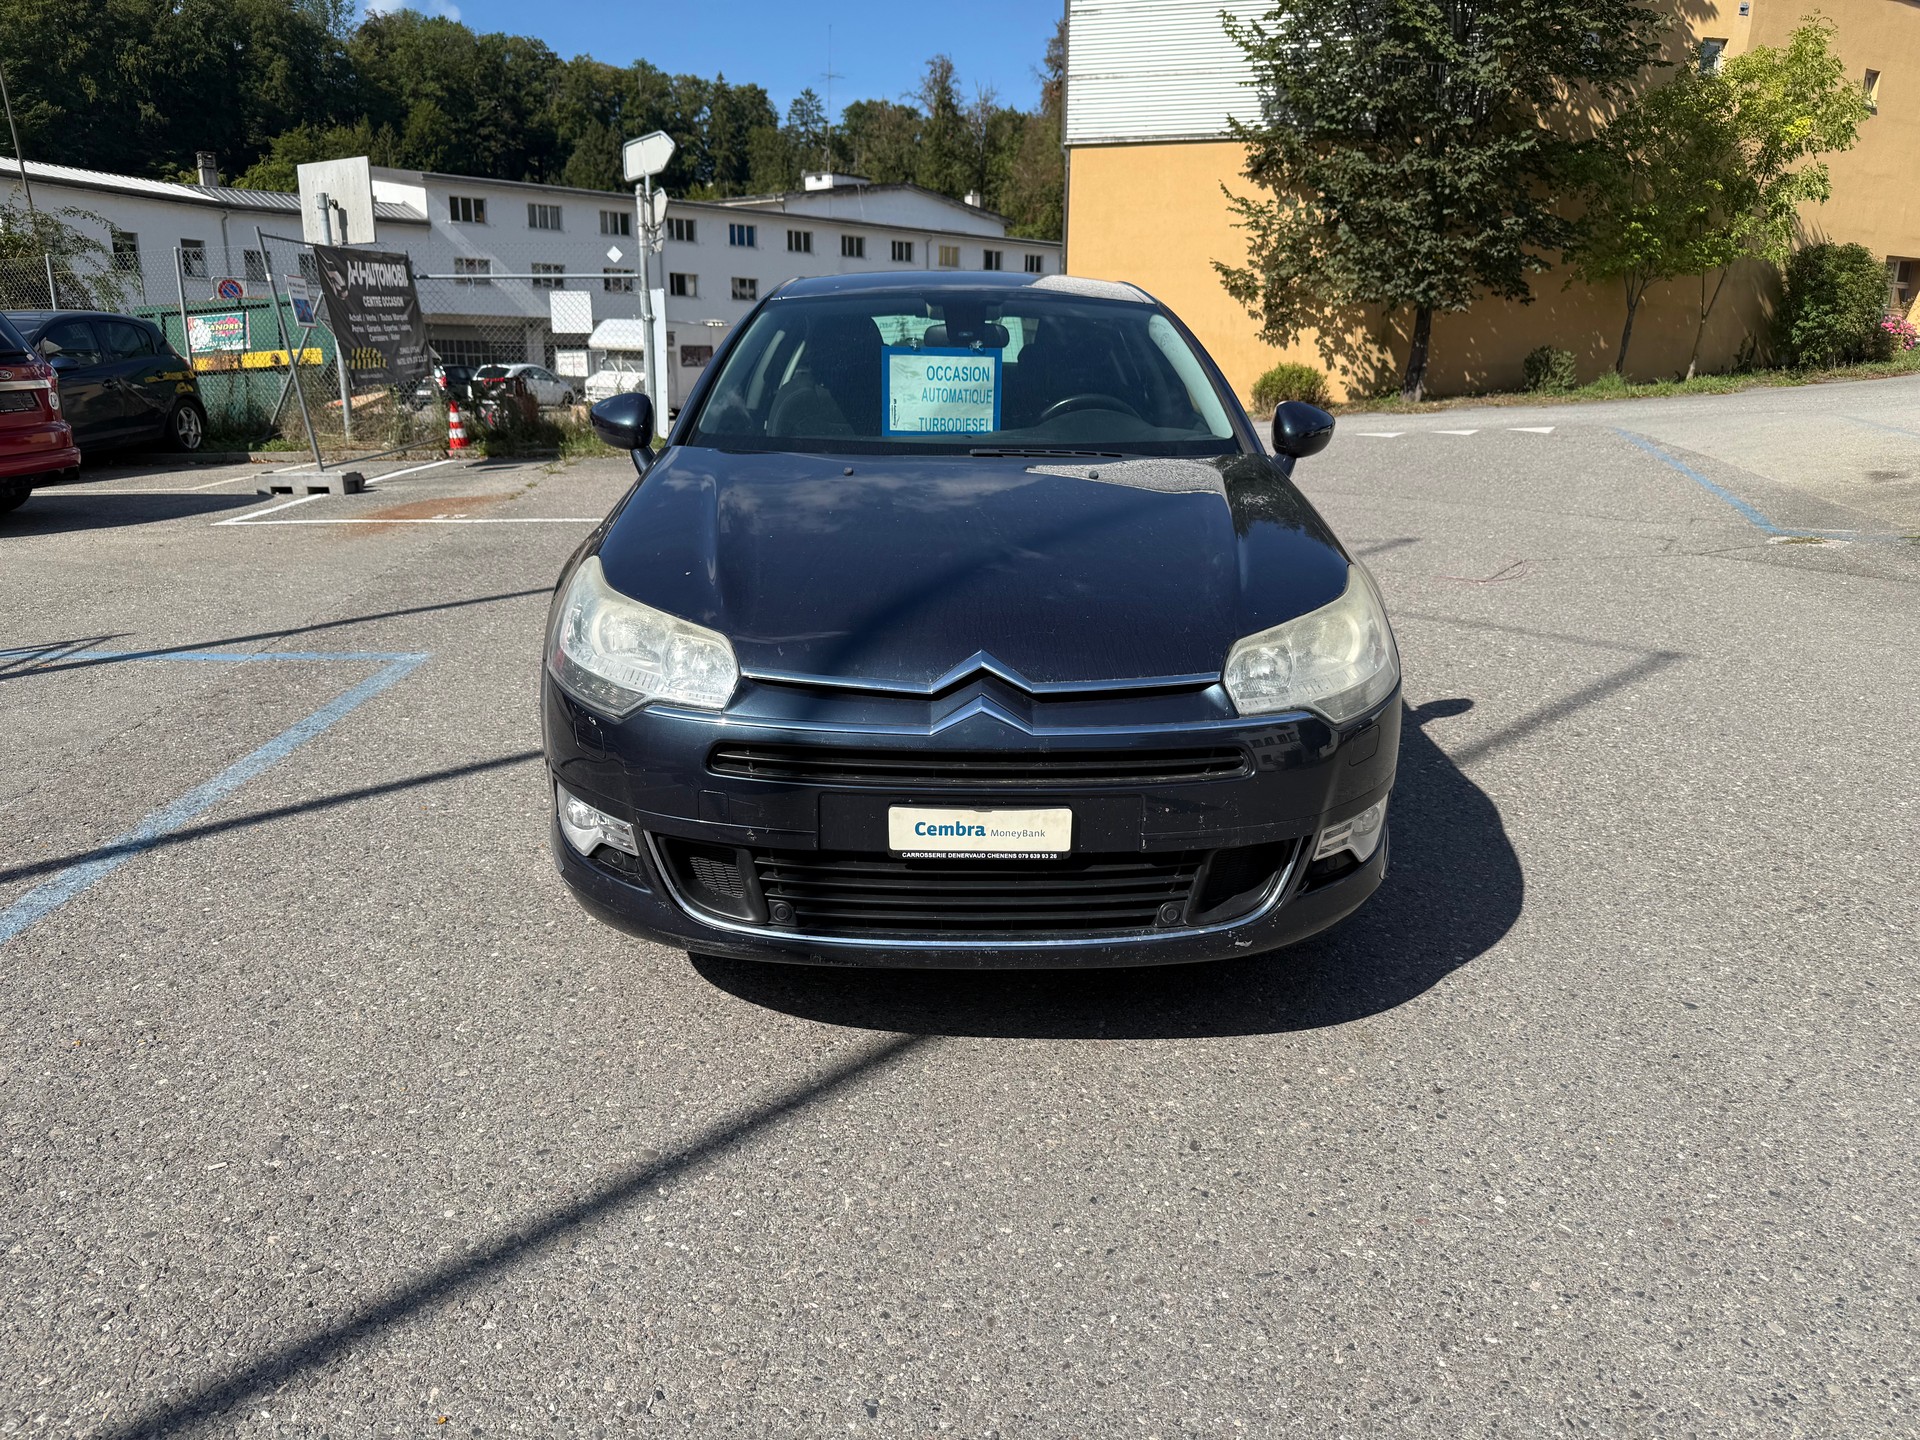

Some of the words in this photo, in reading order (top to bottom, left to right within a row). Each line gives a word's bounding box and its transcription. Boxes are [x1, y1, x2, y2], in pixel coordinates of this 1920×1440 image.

[363, 296, 382, 307] CENTRE
[382, 296, 404, 307] OCCASION
[926, 365, 990, 382] OCCASION
[921, 387, 993, 405] AUTOMATIQUE
[918, 417, 991, 432] TURBODIESEL
[914, 821, 987, 837] Cembra
[990, 829, 1046, 839] MoneyBank
